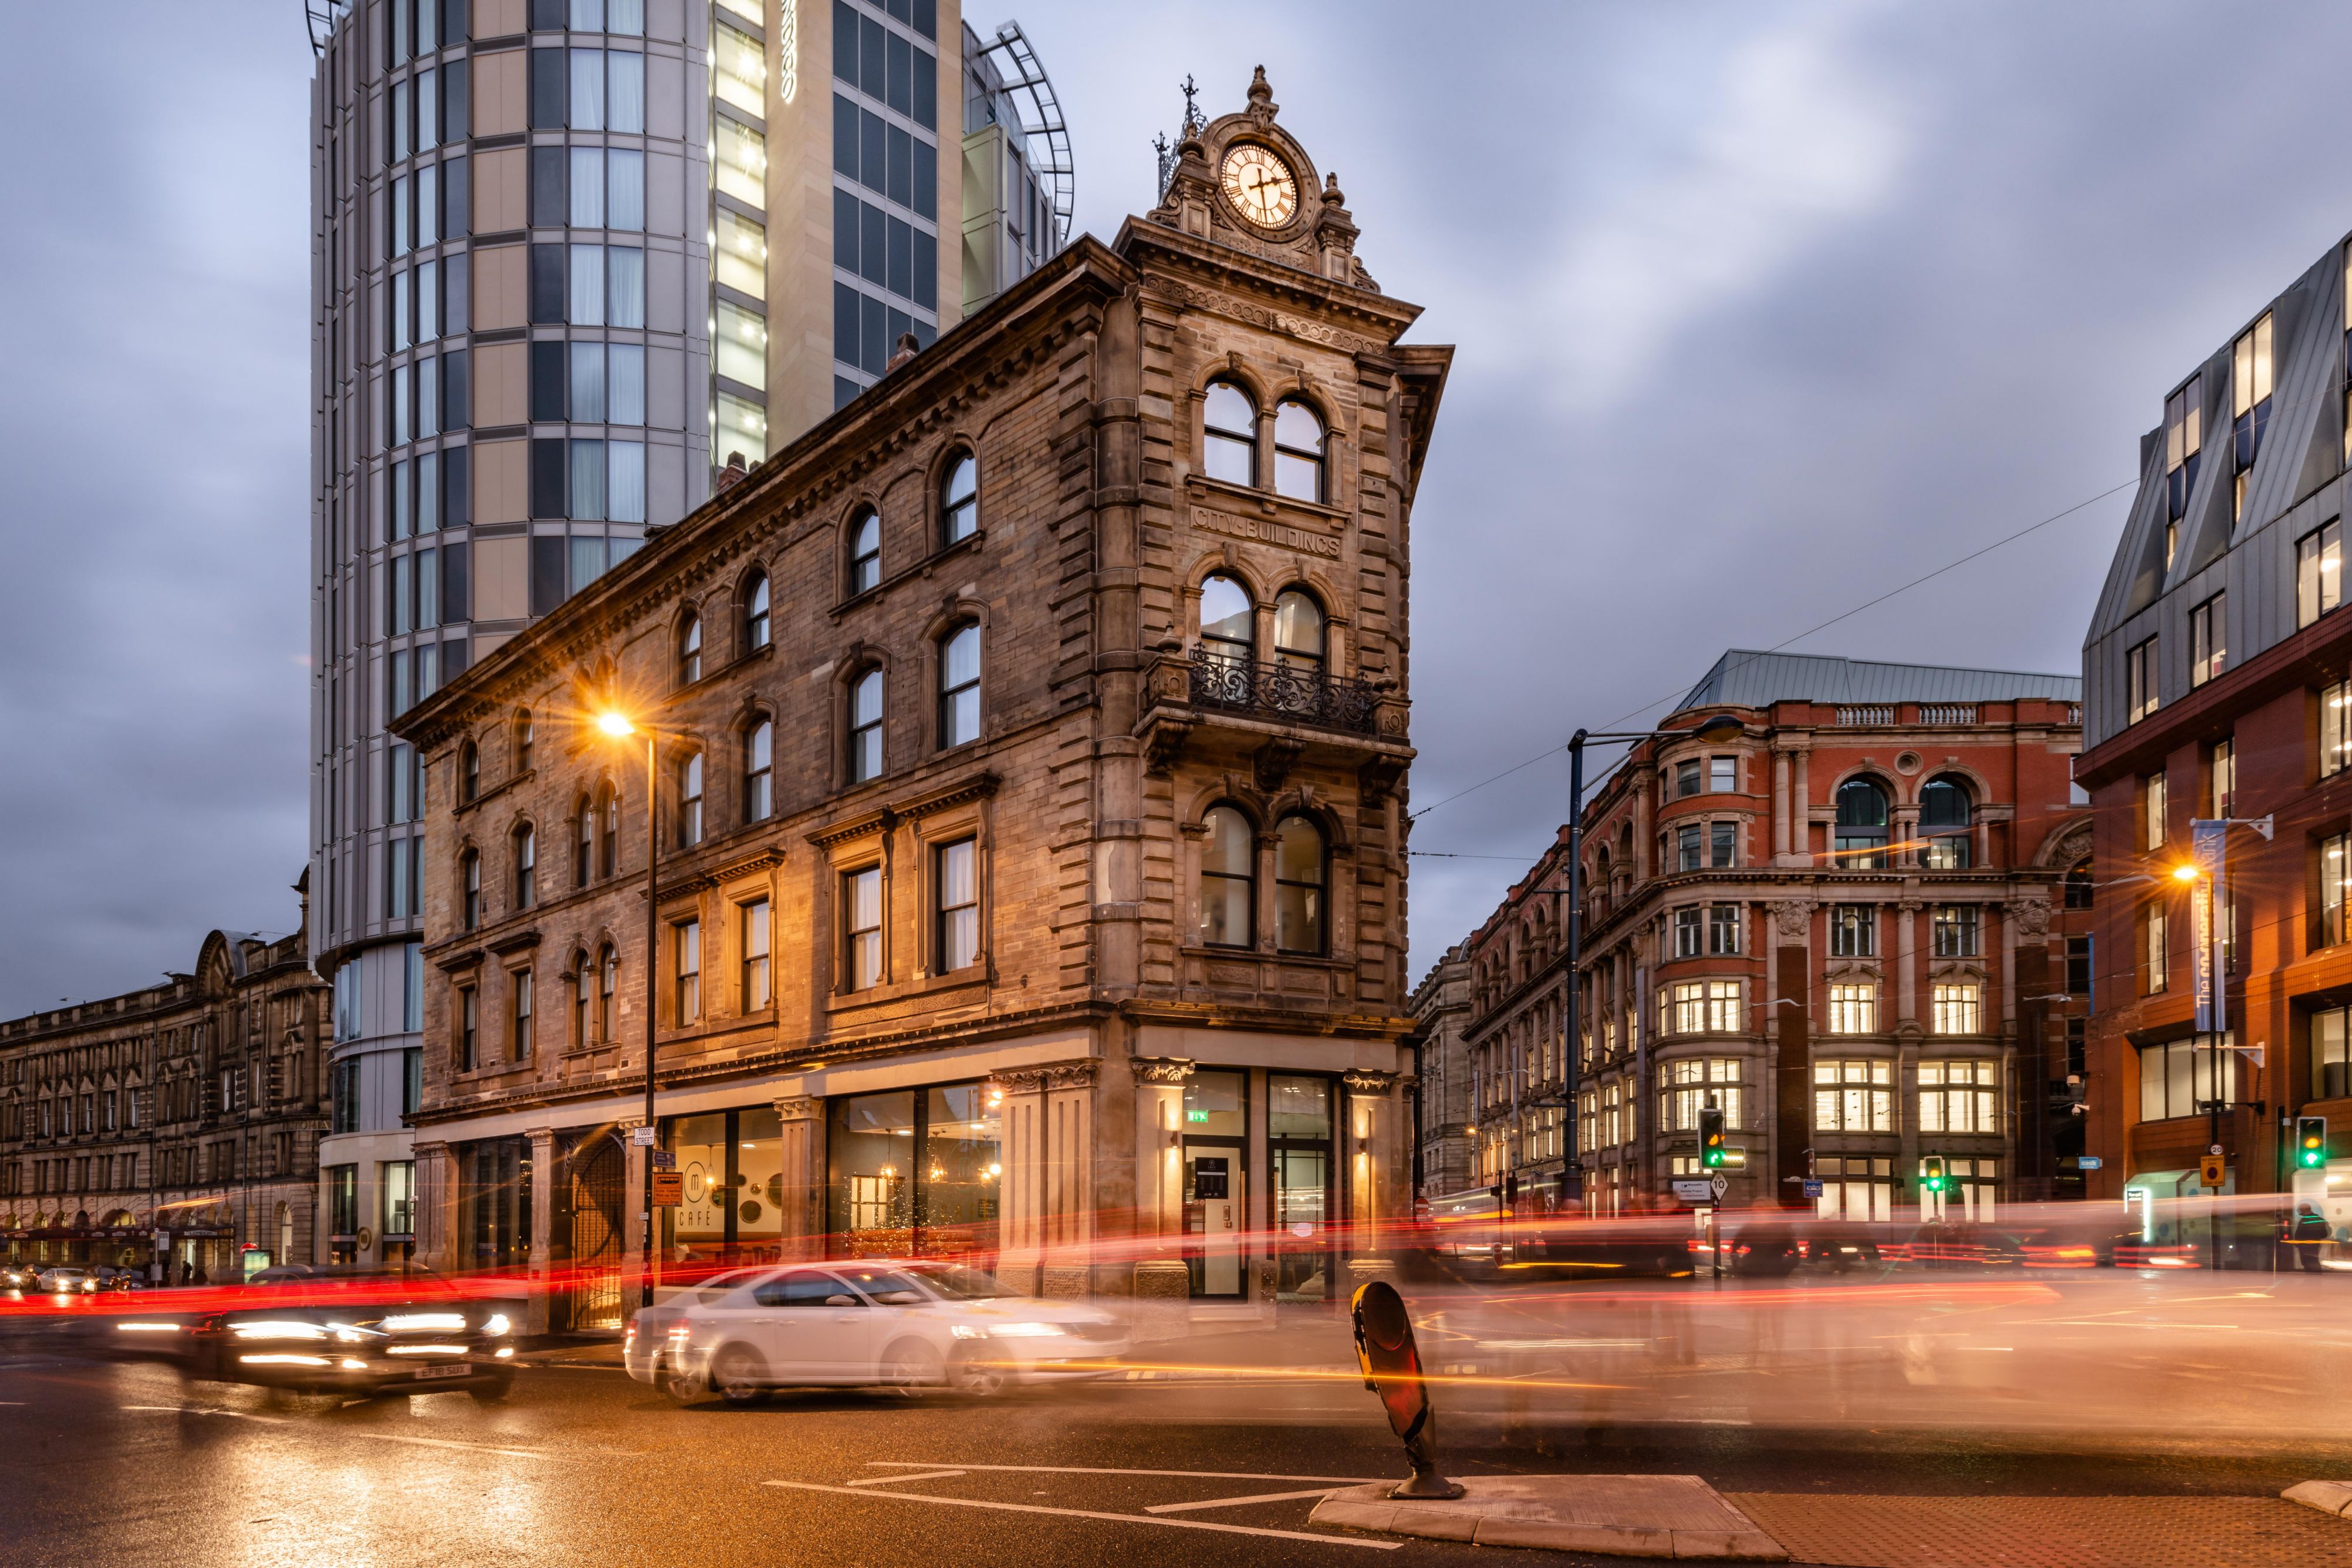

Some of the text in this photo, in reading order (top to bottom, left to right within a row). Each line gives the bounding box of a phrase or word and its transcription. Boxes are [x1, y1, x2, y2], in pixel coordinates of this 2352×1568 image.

[781, 0, 797, 103] NDIGO
[1194, 509, 1339, 556] CITY BUILDINGS
[2196, 980, 2210, 1008] The
[282, 1119, 330, 1131] VICTORIA
[636, 1136, 653, 1145] STREET
[1713, 1180, 1725, 1189] 10
[679, 1205, 710, 1226] CAFÉ
